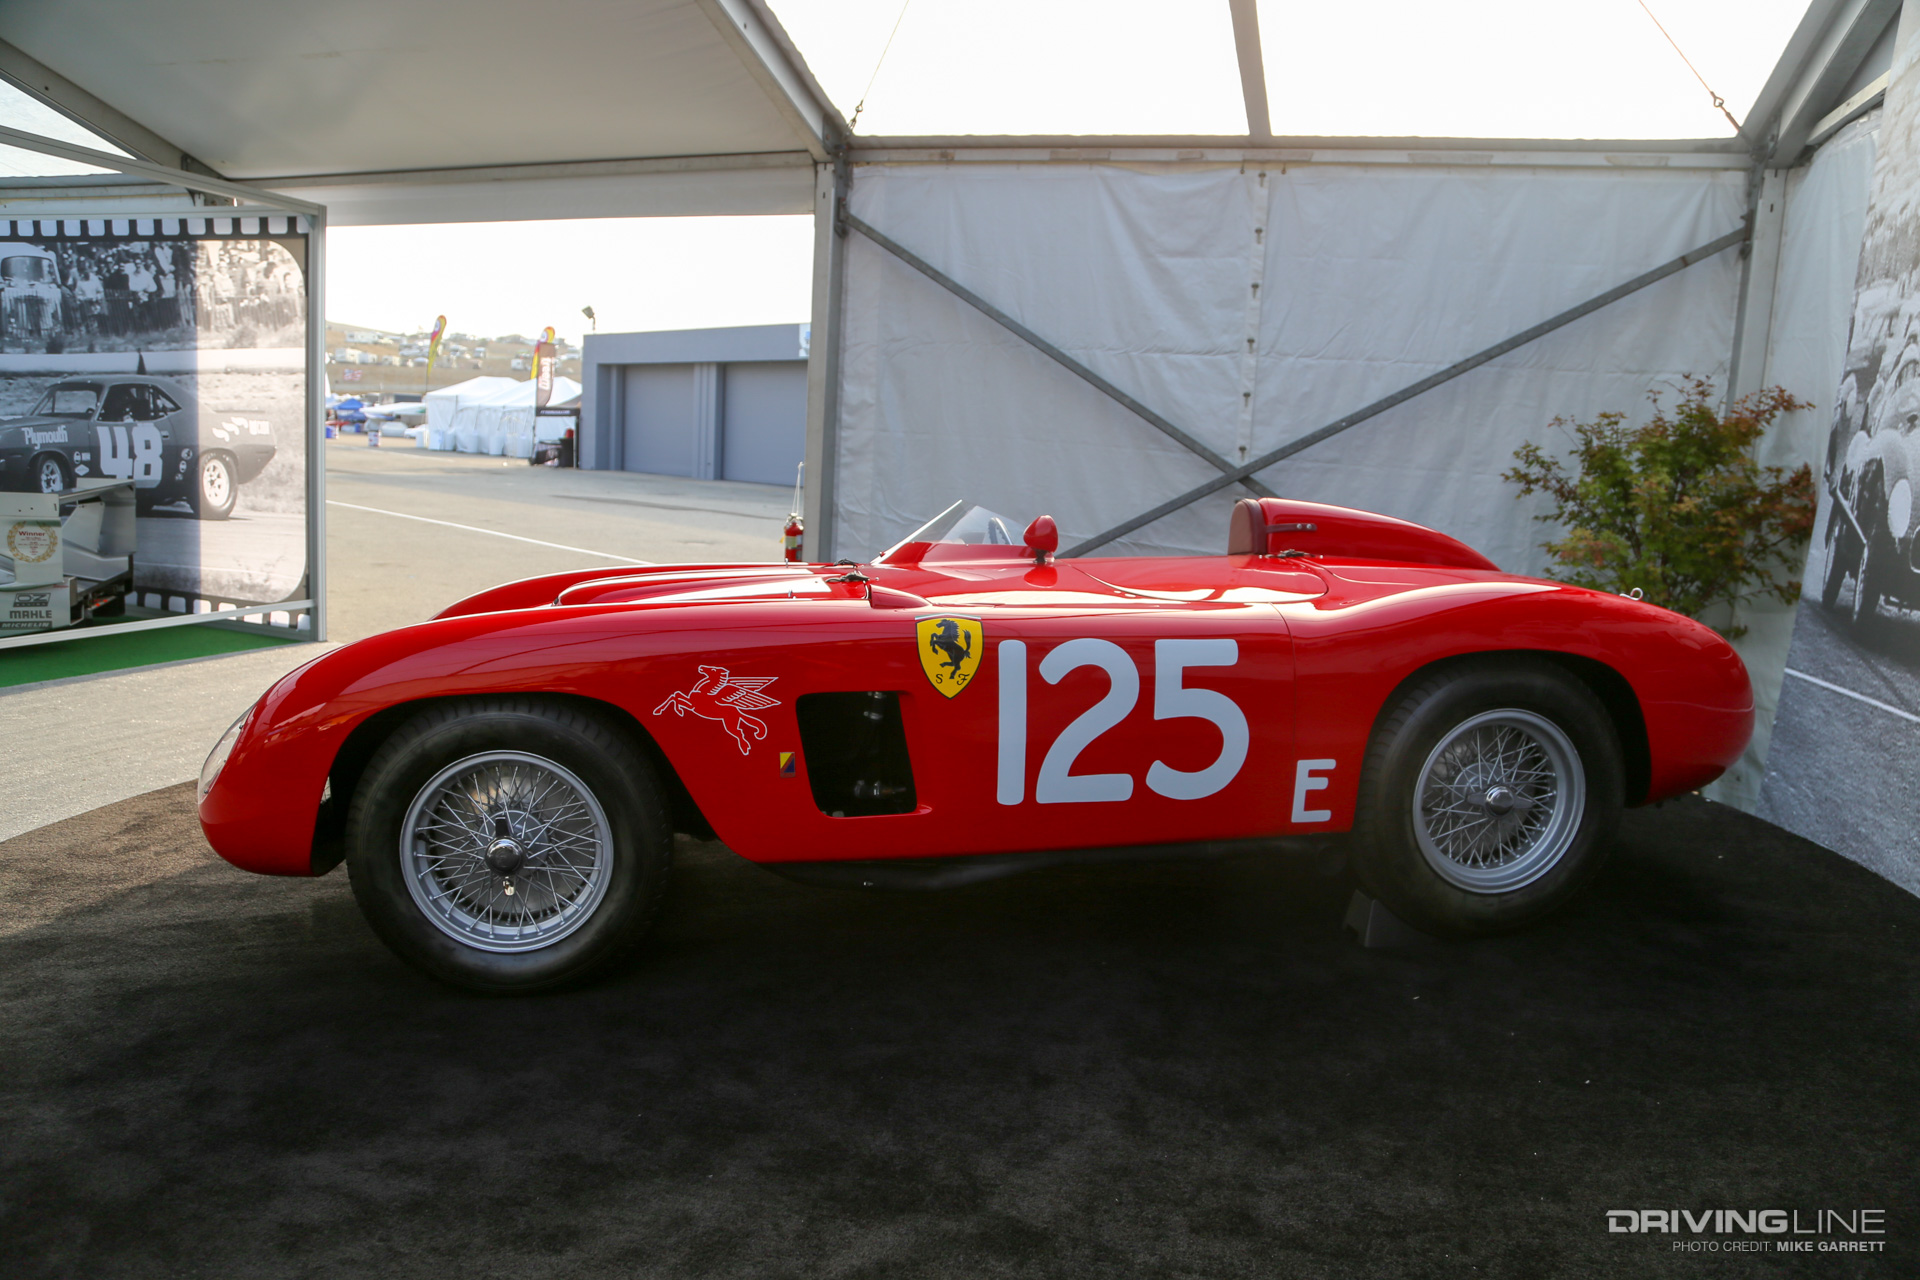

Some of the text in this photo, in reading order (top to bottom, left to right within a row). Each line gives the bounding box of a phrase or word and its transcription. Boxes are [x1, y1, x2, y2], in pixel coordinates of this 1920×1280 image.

[21, 425, 69, 450] Plymouth
[96, 422, 163, 489] 48
[17, 594, 48, 602] OZ
[9, 610, 53, 619] MAHLE
[935, 673, 970, 686] S F
[996, 637, 1250, 806] 125
[1291, 758, 1336, 824] E
